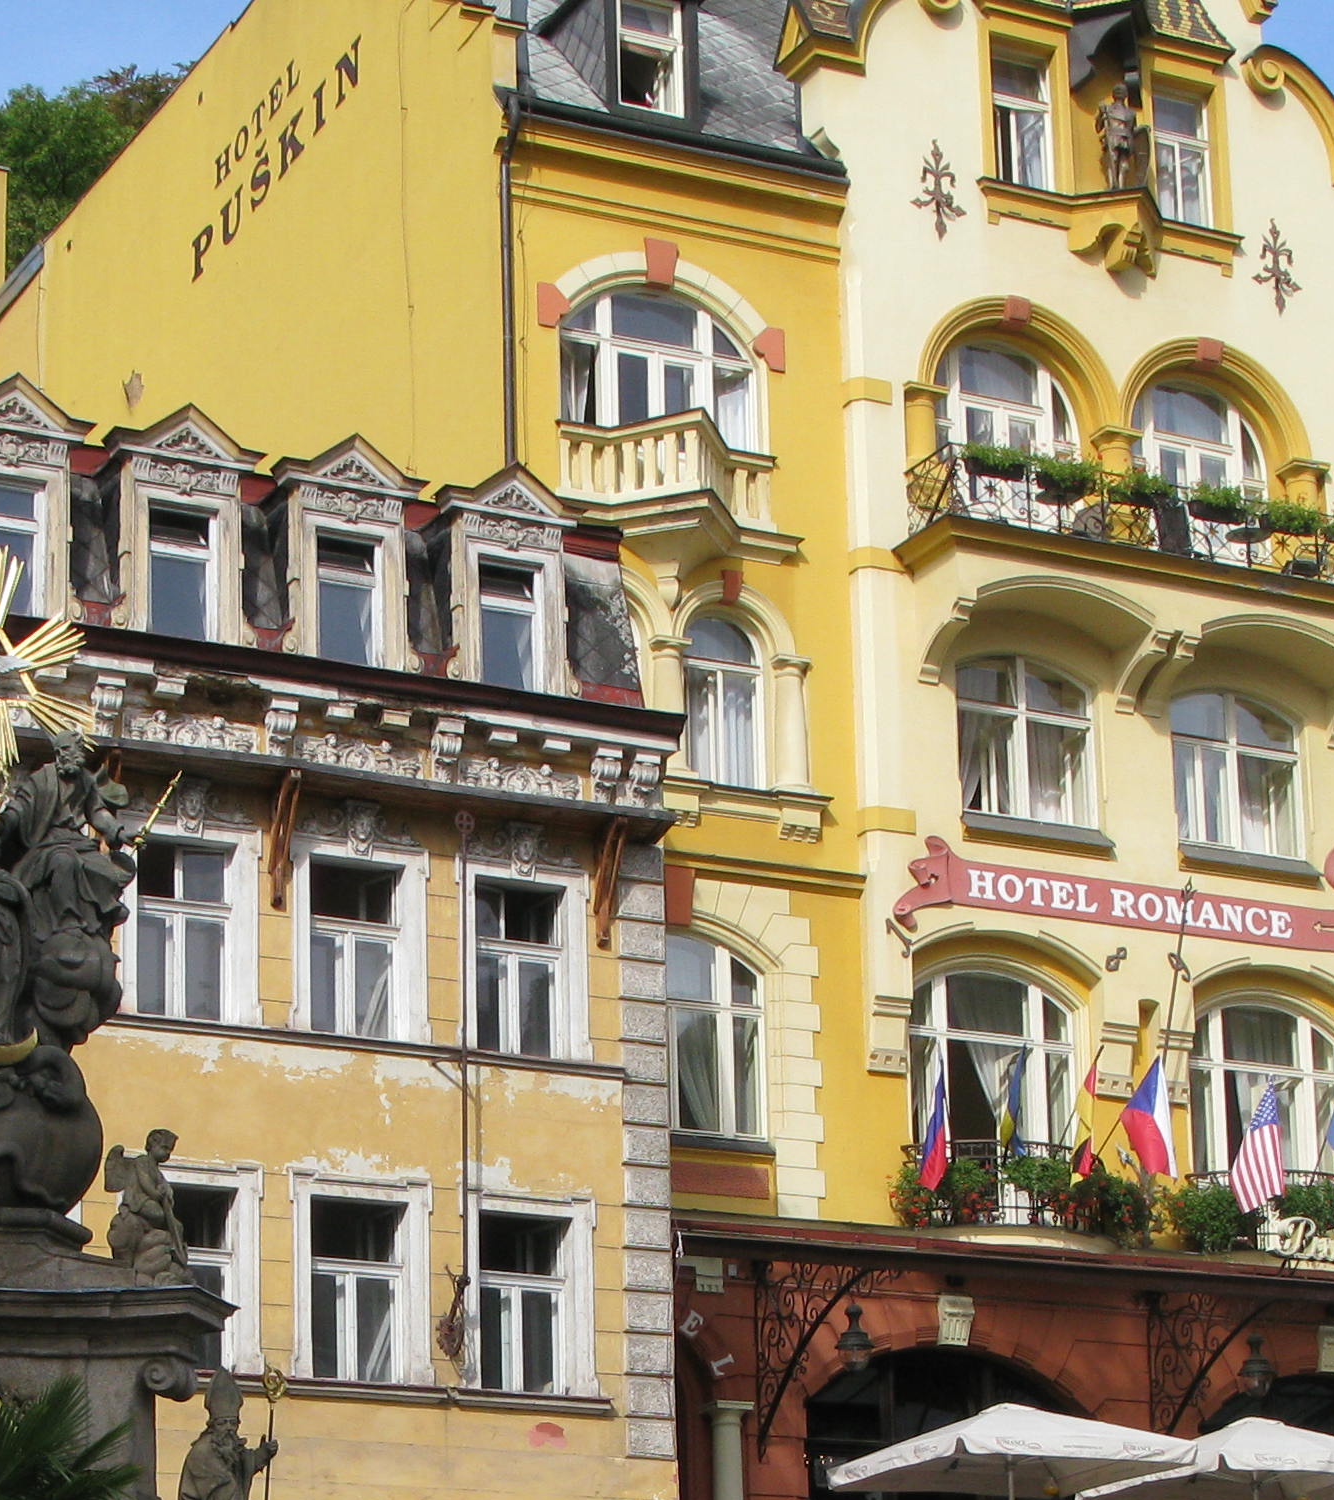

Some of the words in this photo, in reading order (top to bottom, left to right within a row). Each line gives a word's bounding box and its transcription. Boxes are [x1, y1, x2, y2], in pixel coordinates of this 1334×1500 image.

[191, 34, 361, 283] PUŠKIN
[214, 59, 300, 189] HOTEL
[968, 868, 1098, 914] HOTEL
[1110, 887, 1293, 940] ROMANCE
